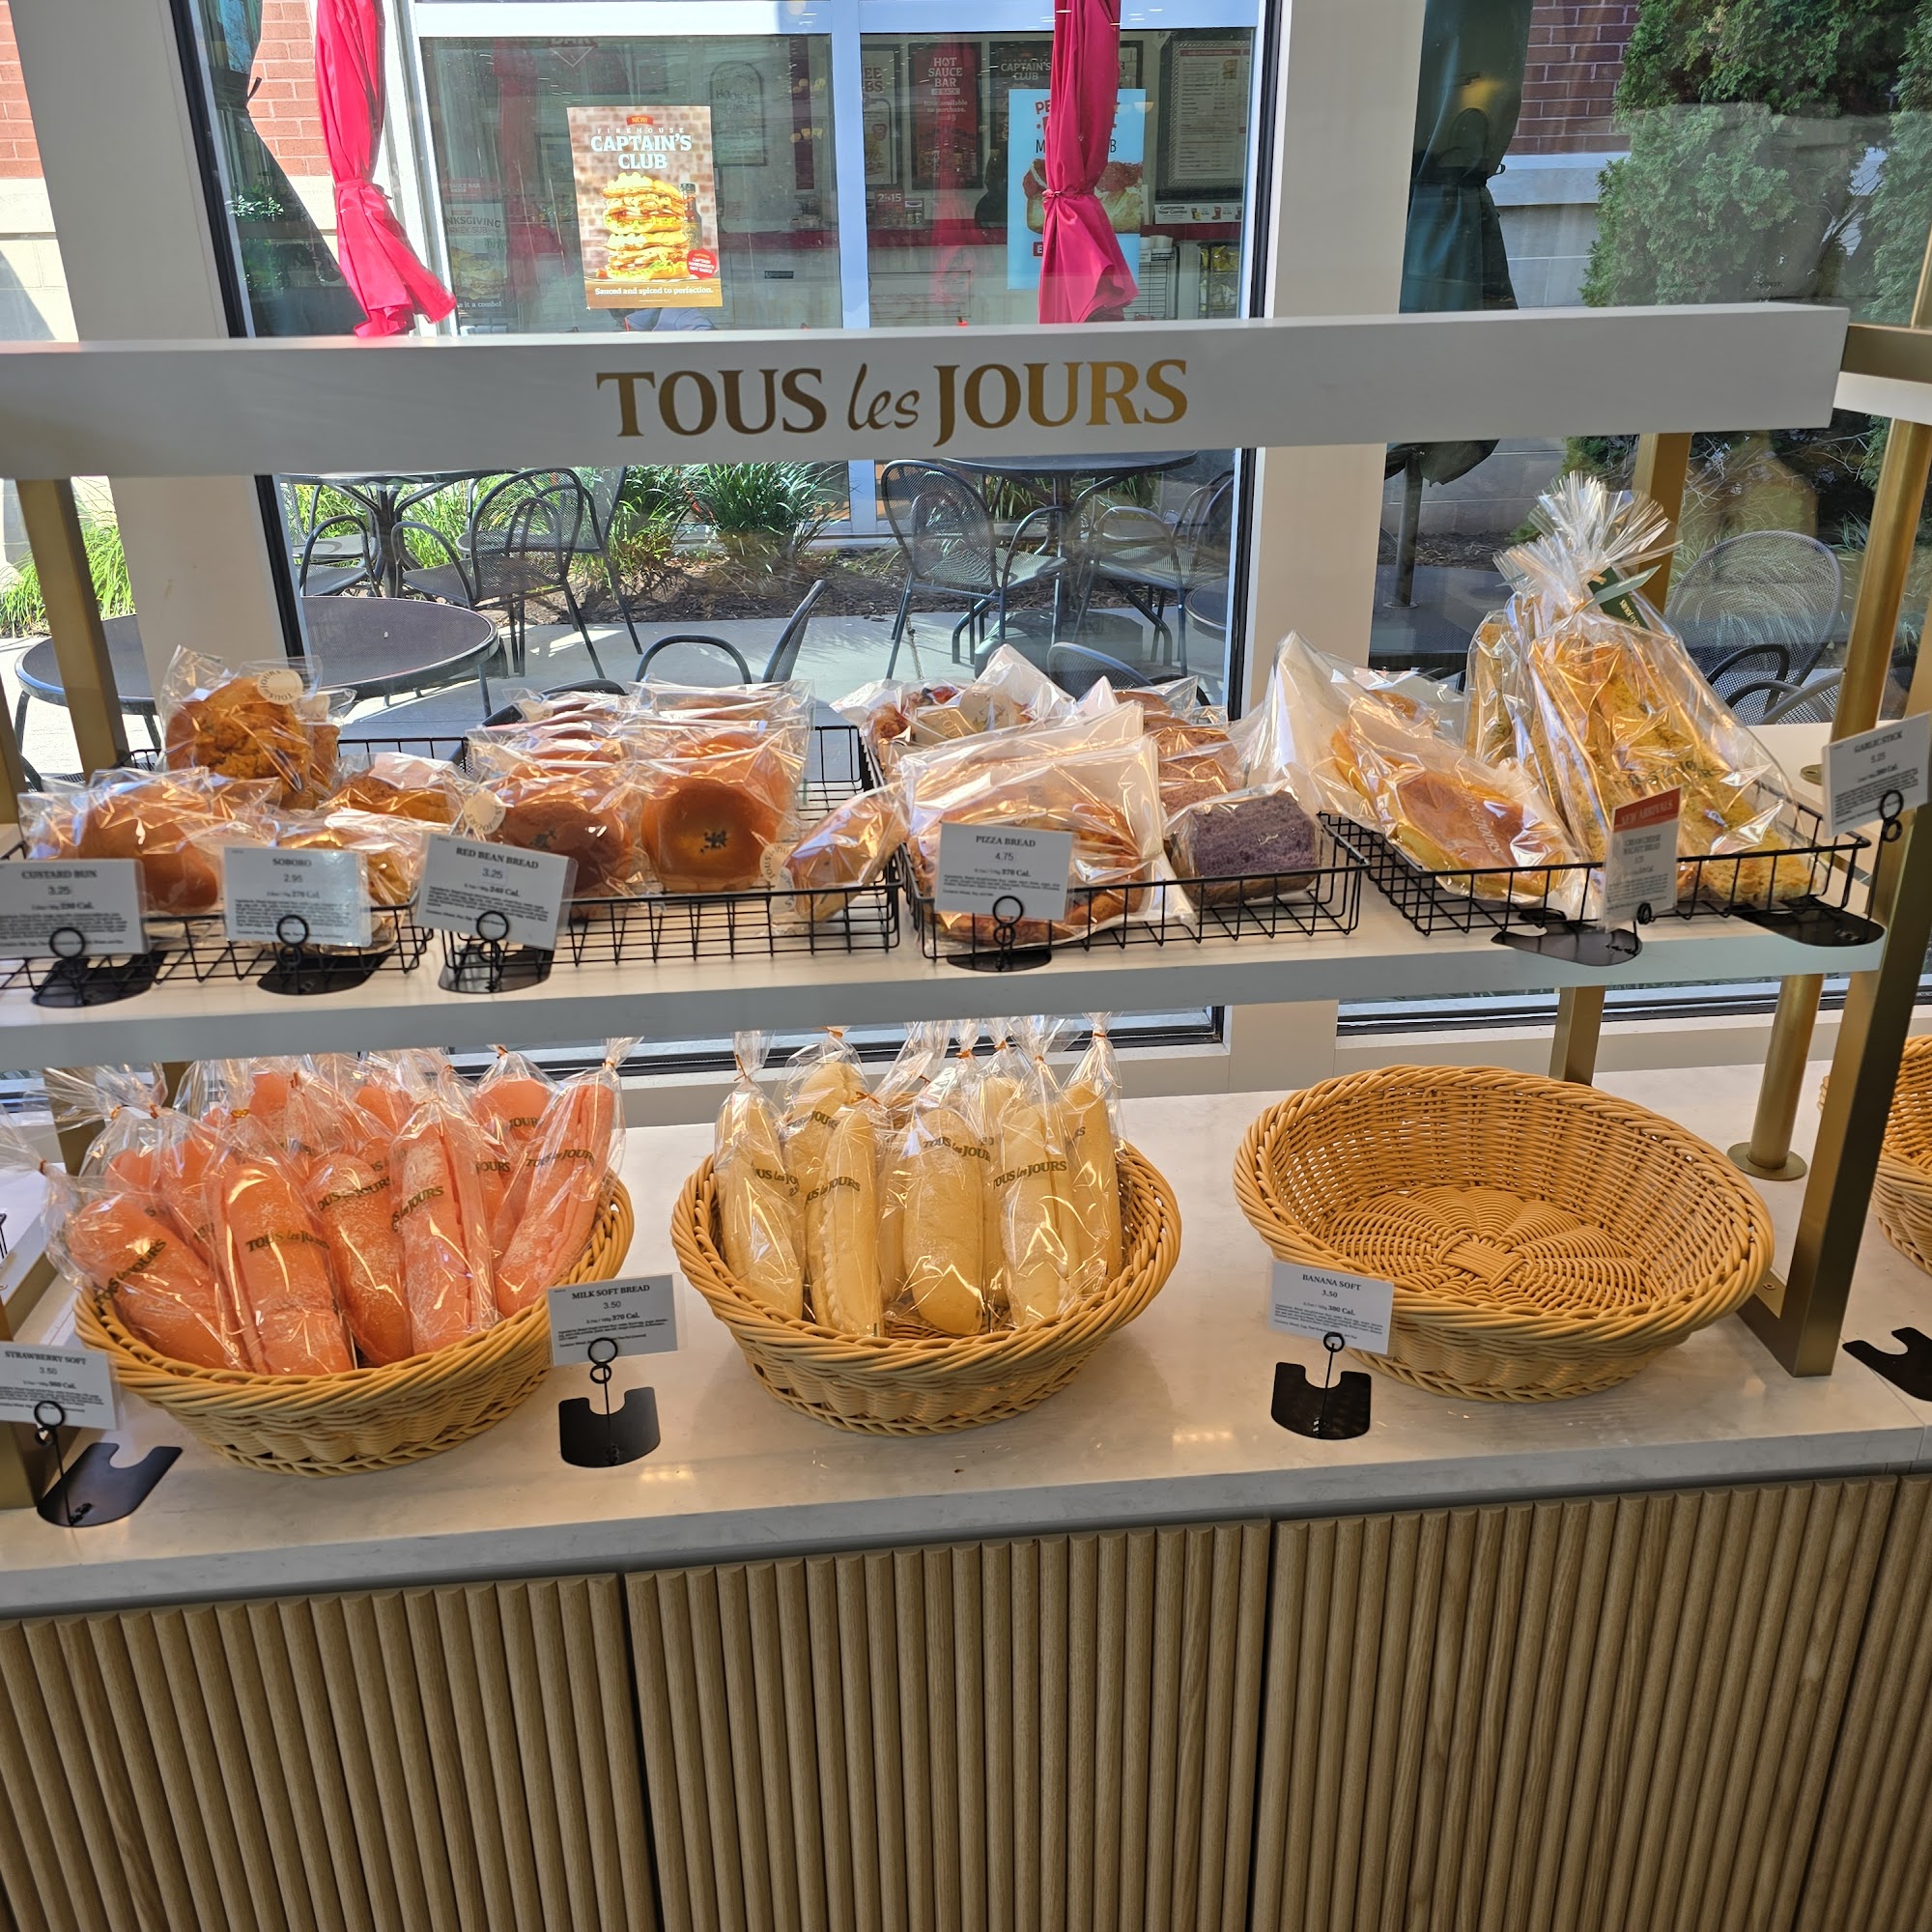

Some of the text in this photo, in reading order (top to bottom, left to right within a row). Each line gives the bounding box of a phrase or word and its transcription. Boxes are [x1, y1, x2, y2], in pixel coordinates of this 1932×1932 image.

[933, 57, 957, 67] HOT
[1001, 61, 1051, 71] CAPTAIN'S
[928, 67, 963, 77] SAUCE
[1013, 71, 1038, 81] CLUB
[934, 77, 957, 88] BAR
[935, 105, 966, 114] purchase.
[590, 132, 693, 152] CAPTAIN'S
[617, 153, 668, 170] CLUB
[446, 216, 501, 228] NKSGIVING
[595, 287, 622, 296] Sauced
[639, 286, 663, 297] spiced
[673, 285, 714, 296] perfection.
[596, 358, 1188, 447] TOUS les JOURS
[938, 709, 960, 738] TOU
[1620, 799, 1673, 826] NEW ARRIVALS
[976, 836, 1037, 848] PIZZA BREAD
[272, 858, 312, 867] SOBORO
[455, 847, 539, 869] RED BEAN BREAD
[995, 852, 1014, 862] 4.75
[21, 869, 98, 879] CUSTARD BUN
[482, 867, 503, 879] 3.25
[504, 888, 521, 897] Cal.
[76, 901, 95, 910] Cal.
[509, 1117, 539, 1129] JOUR
[923, 1136, 952, 1149] TOUS
[961, 1145, 991, 1163] JOUR
[1027, 1160, 1067, 1178] JOURS
[828, 1176, 862, 1193] JOURS
[317, 1191, 341, 1212] OUS
[408, 1186, 444, 1213] JOURS
[128, 1238, 167, 1273] JOURS
[1302, 1273, 1362, 1291] BANANA SOFT
[572, 1284, 650, 1299] MILK SOFT BREAD
[1321, 1289, 1338, 1298] 3.50
[603, 1300, 622, 1310] 3.50
[1341, 1307, 1356, 1316] Cal.
[4, 1350, 87, 1365] STRAWBERRY SOFT
